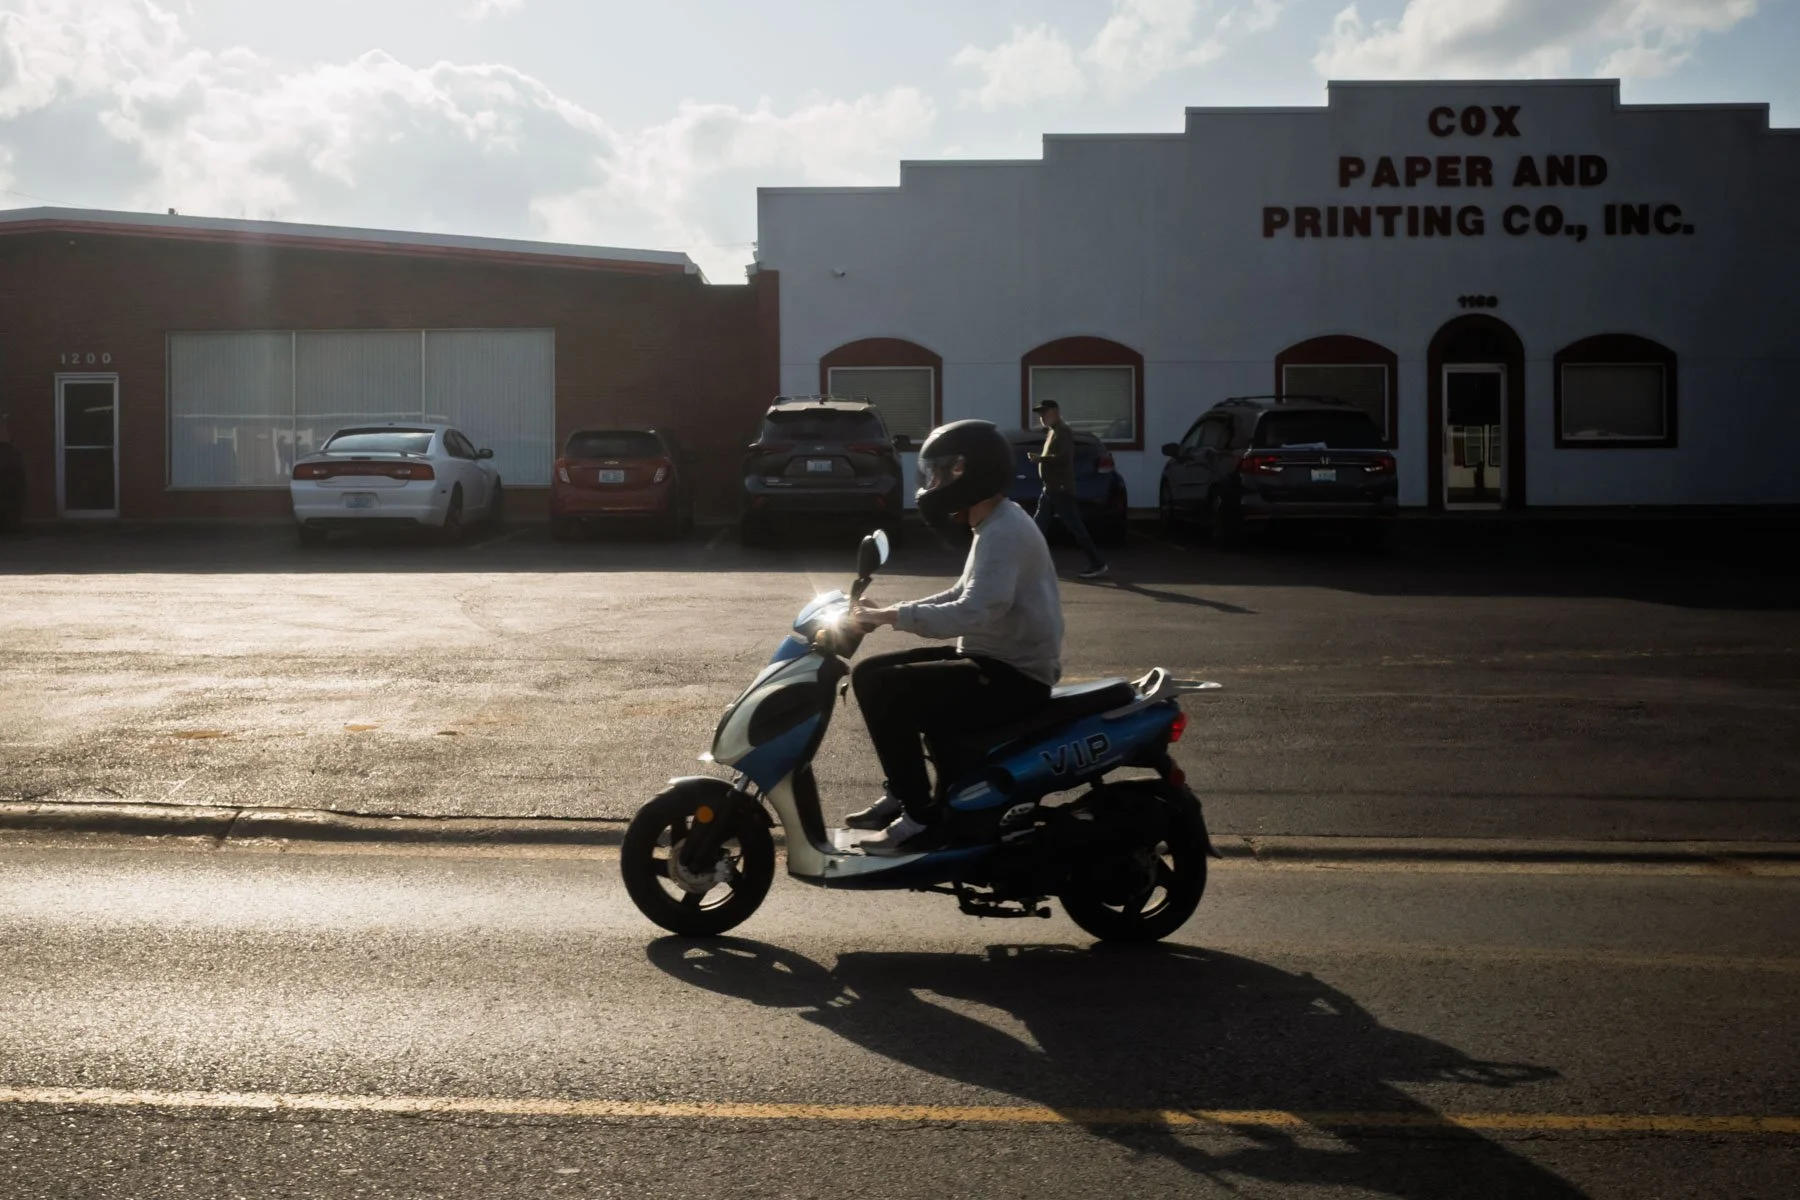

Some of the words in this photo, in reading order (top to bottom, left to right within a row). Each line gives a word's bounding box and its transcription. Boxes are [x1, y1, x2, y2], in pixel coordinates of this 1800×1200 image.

[1428, 105, 1521, 137] COX
[1339, 155, 1493, 188] PAPER
[1512, 154, 1607, 187] AND
[1263, 205, 1484, 238] PRINTING
[1502, 204, 1588, 243] CO.,
[1604, 203, 1695, 236] INC.
[60, 352, 112, 365] 1200
[1039, 732, 1112, 776] VIP
